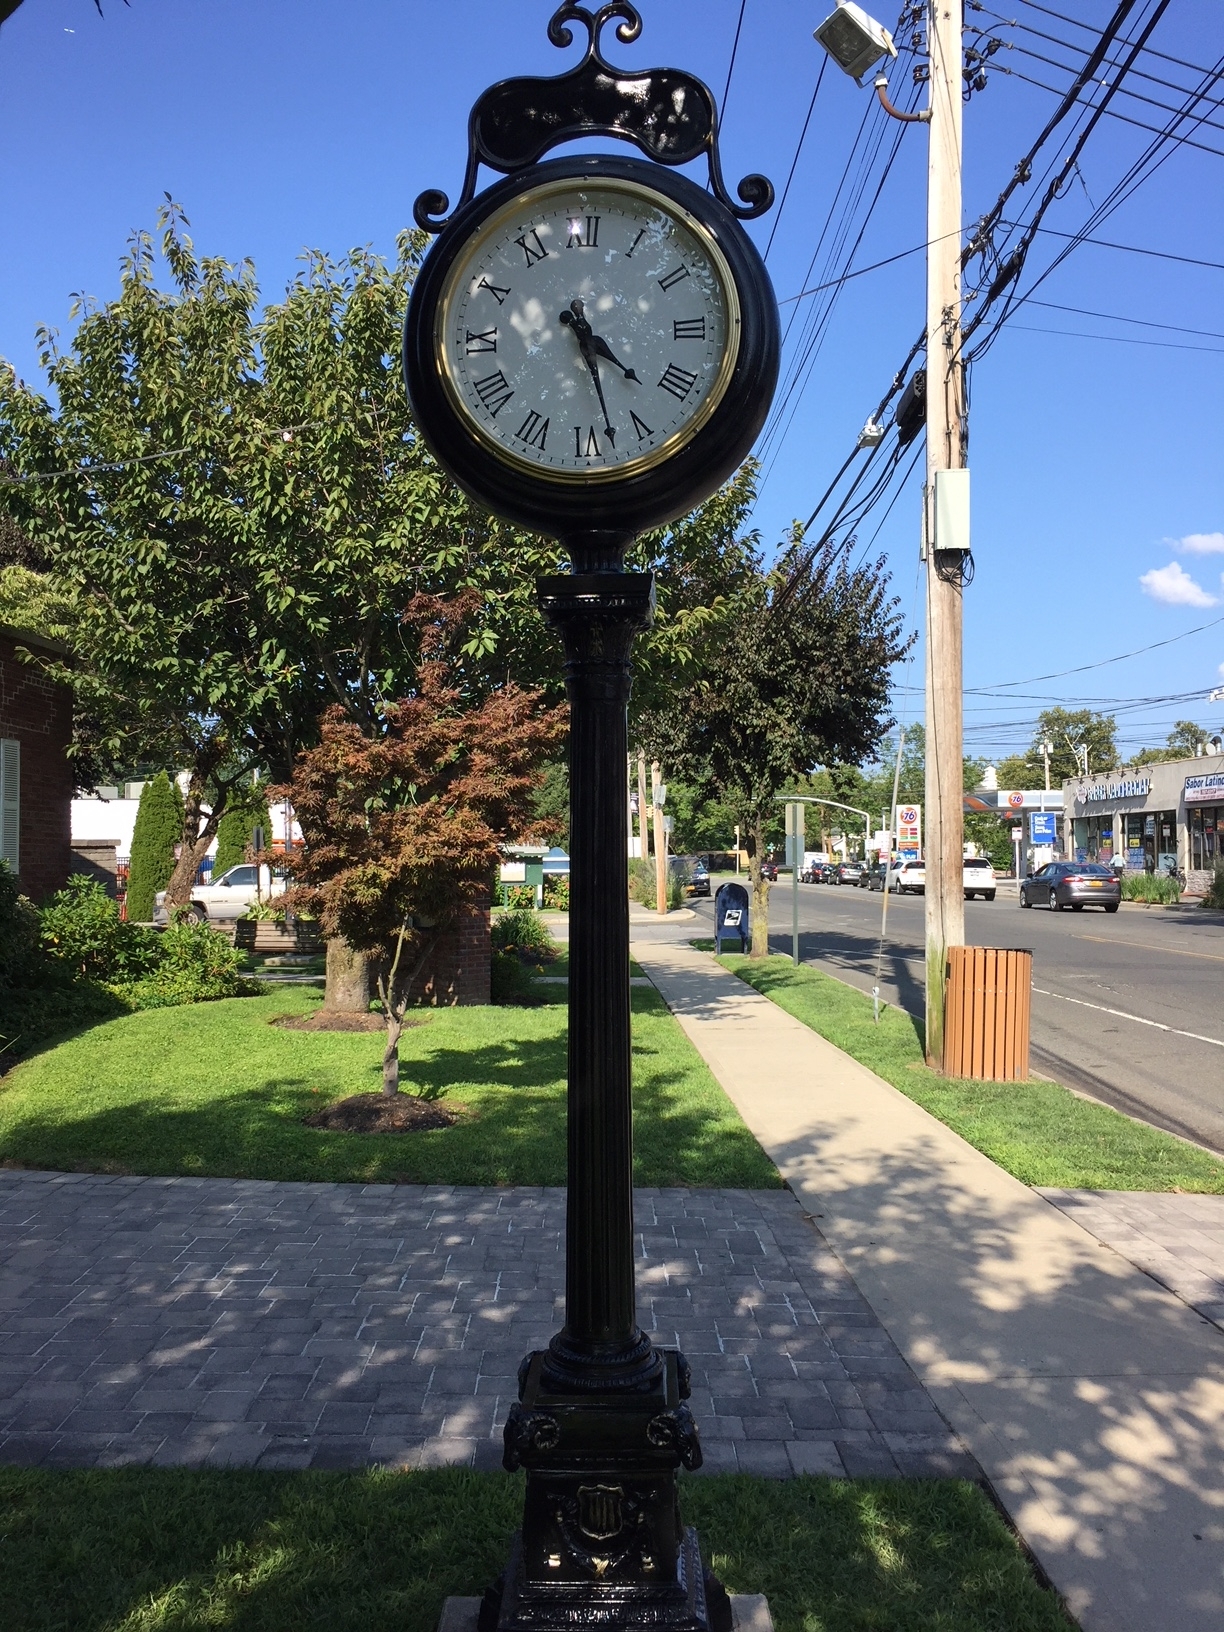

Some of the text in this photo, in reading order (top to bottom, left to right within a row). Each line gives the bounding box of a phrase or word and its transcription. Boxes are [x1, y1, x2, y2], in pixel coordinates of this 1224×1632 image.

[513, 228, 549, 268] XI
[566, 216, 601, 248] XII
[625, 228, 646, 258] I
[477, 276, 511, 305] X
[657, 263, 691, 292] II
[466, 327, 497, 355] IX
[673, 316, 705, 340] III
[473, 370, 515, 419] VIII
[657, 362, 698, 402] IIII
[514, 409, 550, 451] VII
[574, 426, 602, 458] VI
[629, 410, 654, 442] V
[1185, 778, 1204, 789] Sabor
